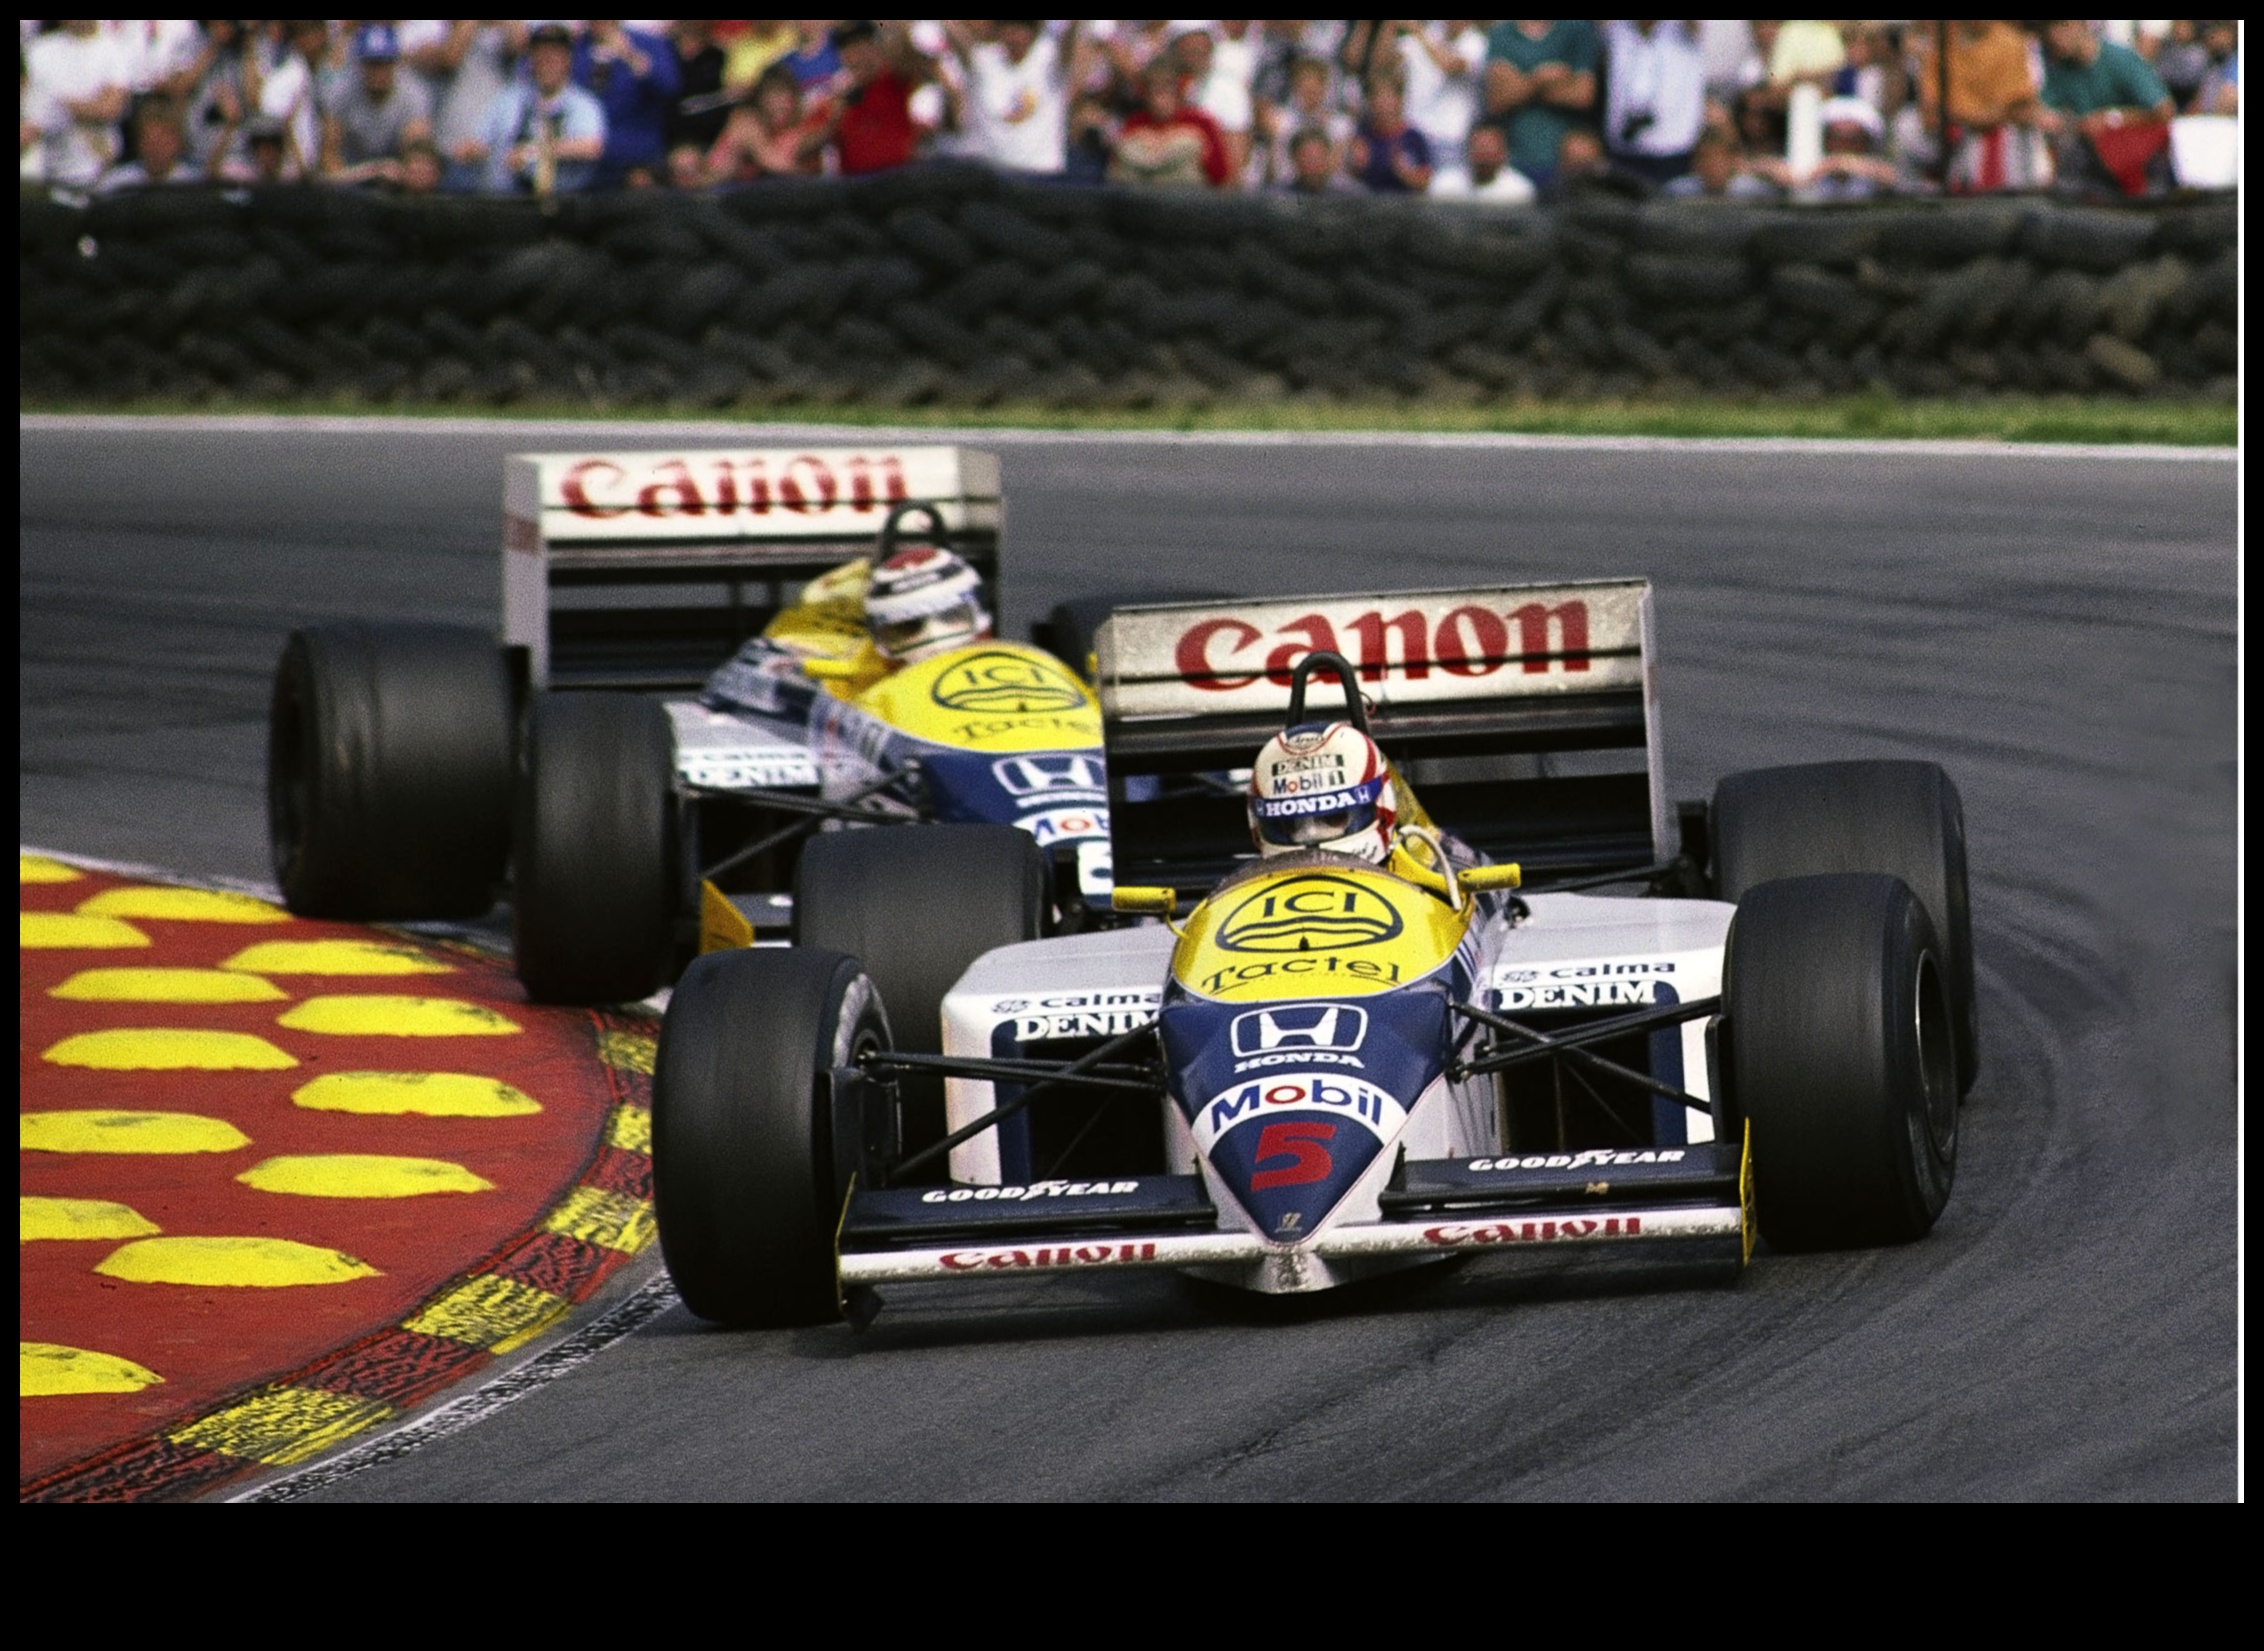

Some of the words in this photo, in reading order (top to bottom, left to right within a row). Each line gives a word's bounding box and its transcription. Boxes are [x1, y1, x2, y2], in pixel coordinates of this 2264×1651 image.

[560, 453, 910, 519] Canon
[1175, 599, 1591, 692] Canon
[964, 664, 1044, 687] ICI
[1273, 773, 1324, 795] Mobil
[1265, 792, 1358, 817] HONDA
[1262, 891, 1358, 918] ICI
[1201, 956, 1401, 995] Tactel
[1549, 962, 1676, 979] calma
[1499, 980, 1658, 1011] DENIM
[1233, 1052, 1366, 1074] HONDA
[1211, 1079, 1383, 1135] Mobil
[1249, 1121, 1338, 1193] 5
[1468, 1149, 1686, 1172] GOODYEAR
[921, 1180, 1139, 1204] GOODYEAR
[1423, 1217, 1641, 1246] Canon
[938, 1242, 1156, 1271] Canon
